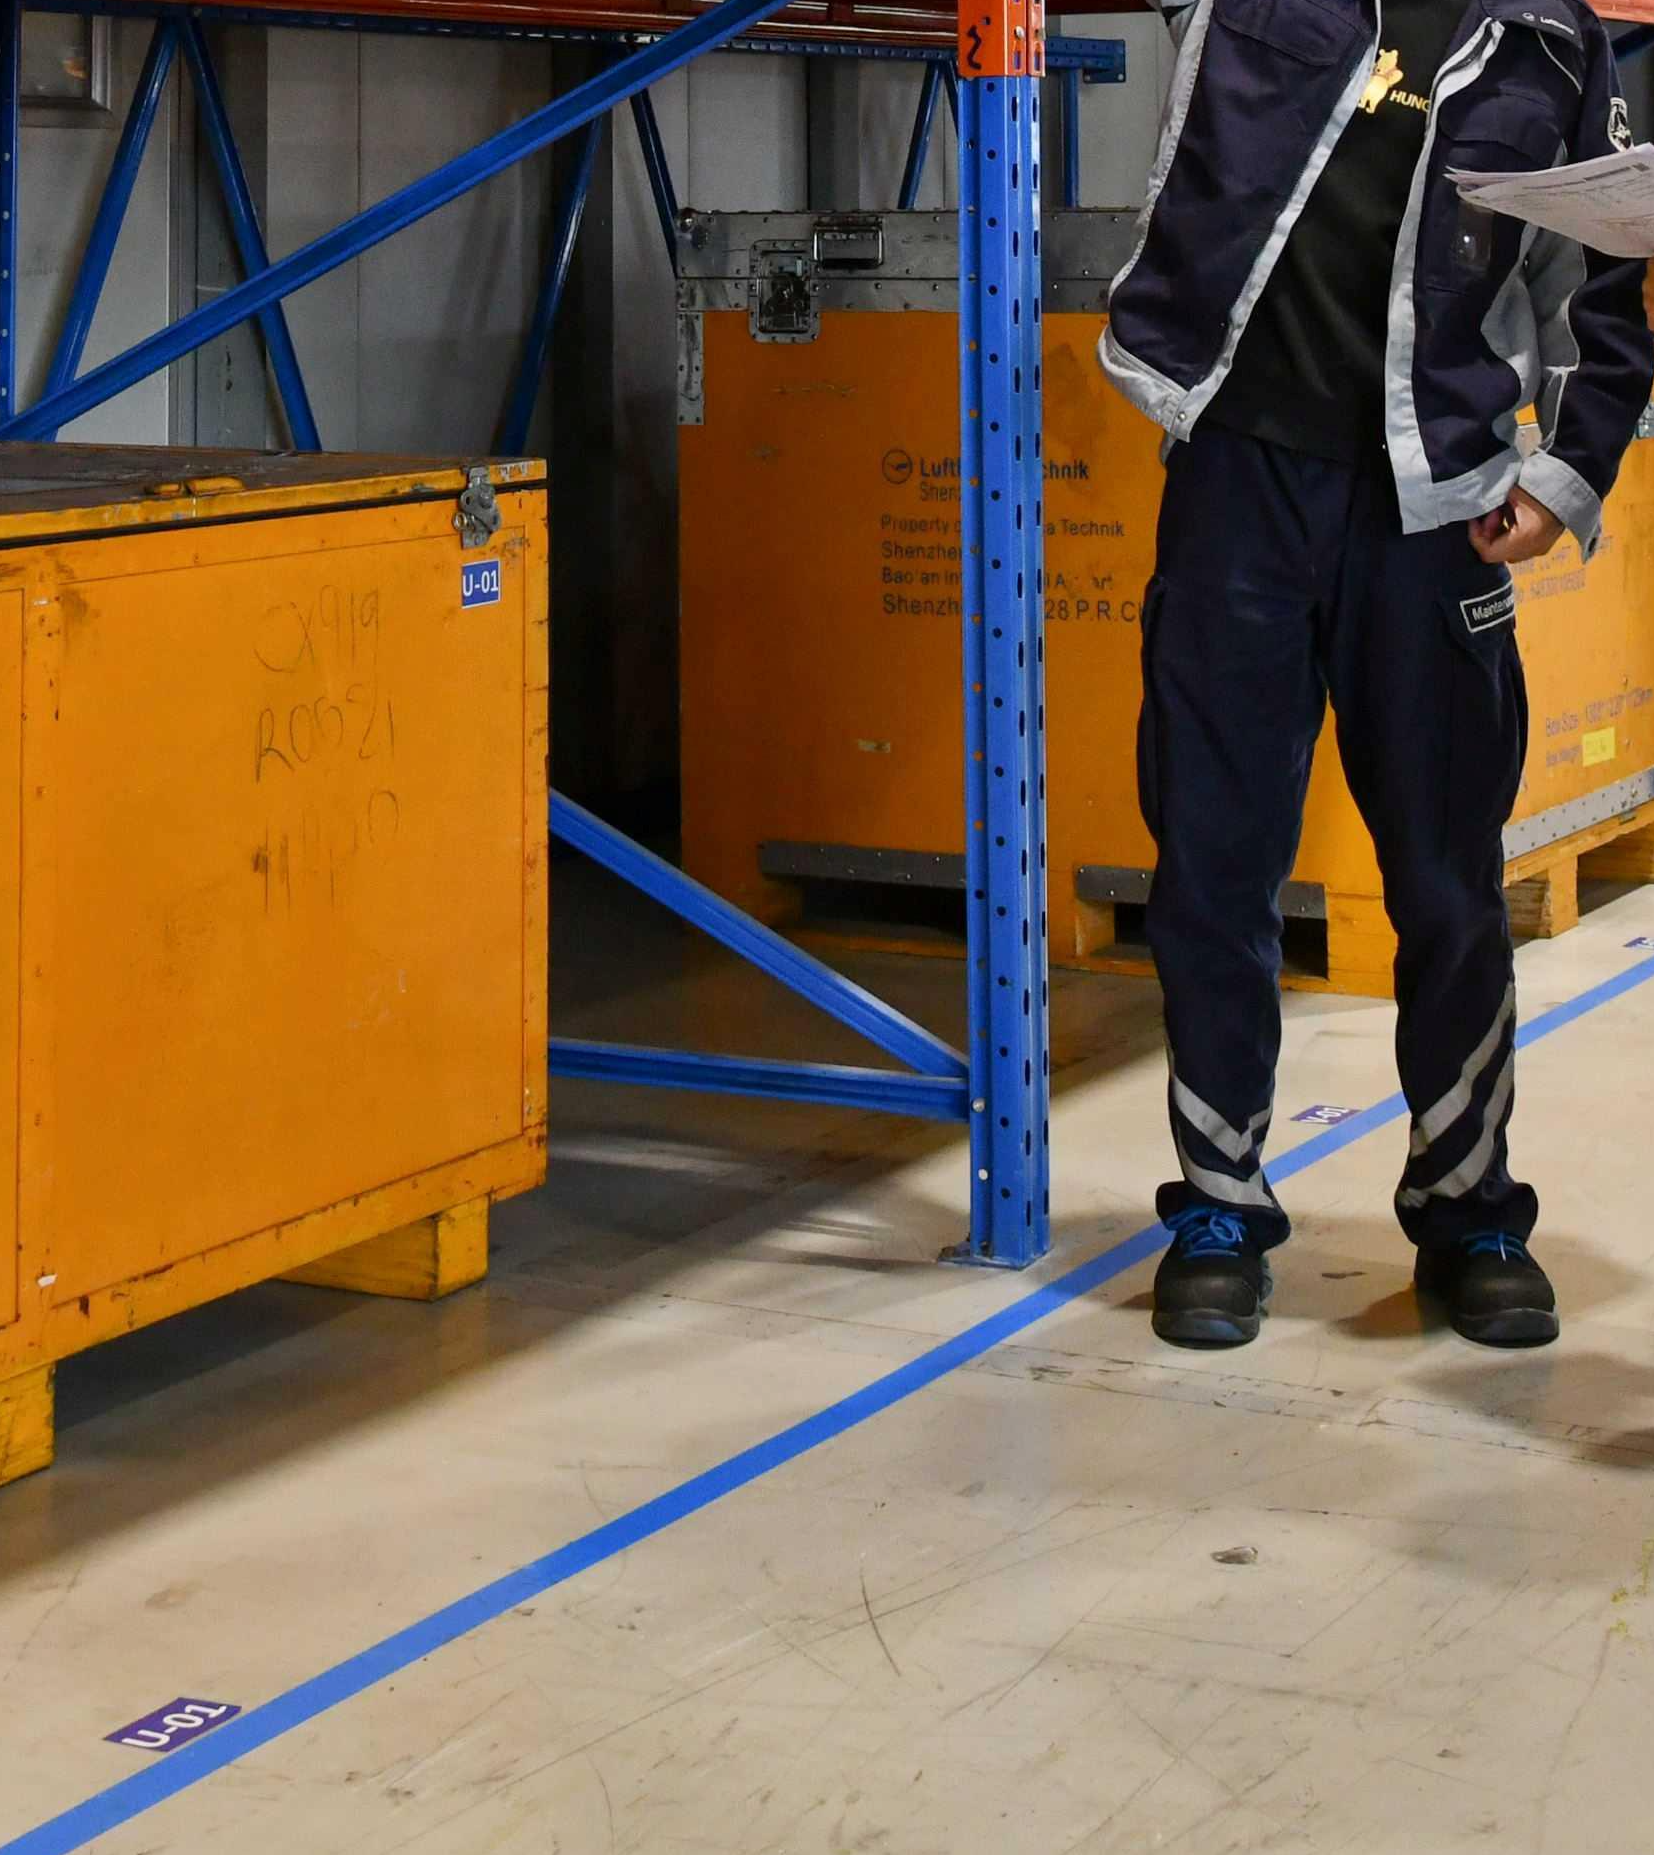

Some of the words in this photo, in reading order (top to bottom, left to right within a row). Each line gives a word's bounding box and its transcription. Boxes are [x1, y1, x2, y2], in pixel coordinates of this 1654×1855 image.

[1061, 519, 1124, 538] Technik
[881, 540, 961, 560] Shenzhe
[462, 569, 500, 597] U-01
[121, 1701, 228, 1750] U-01
